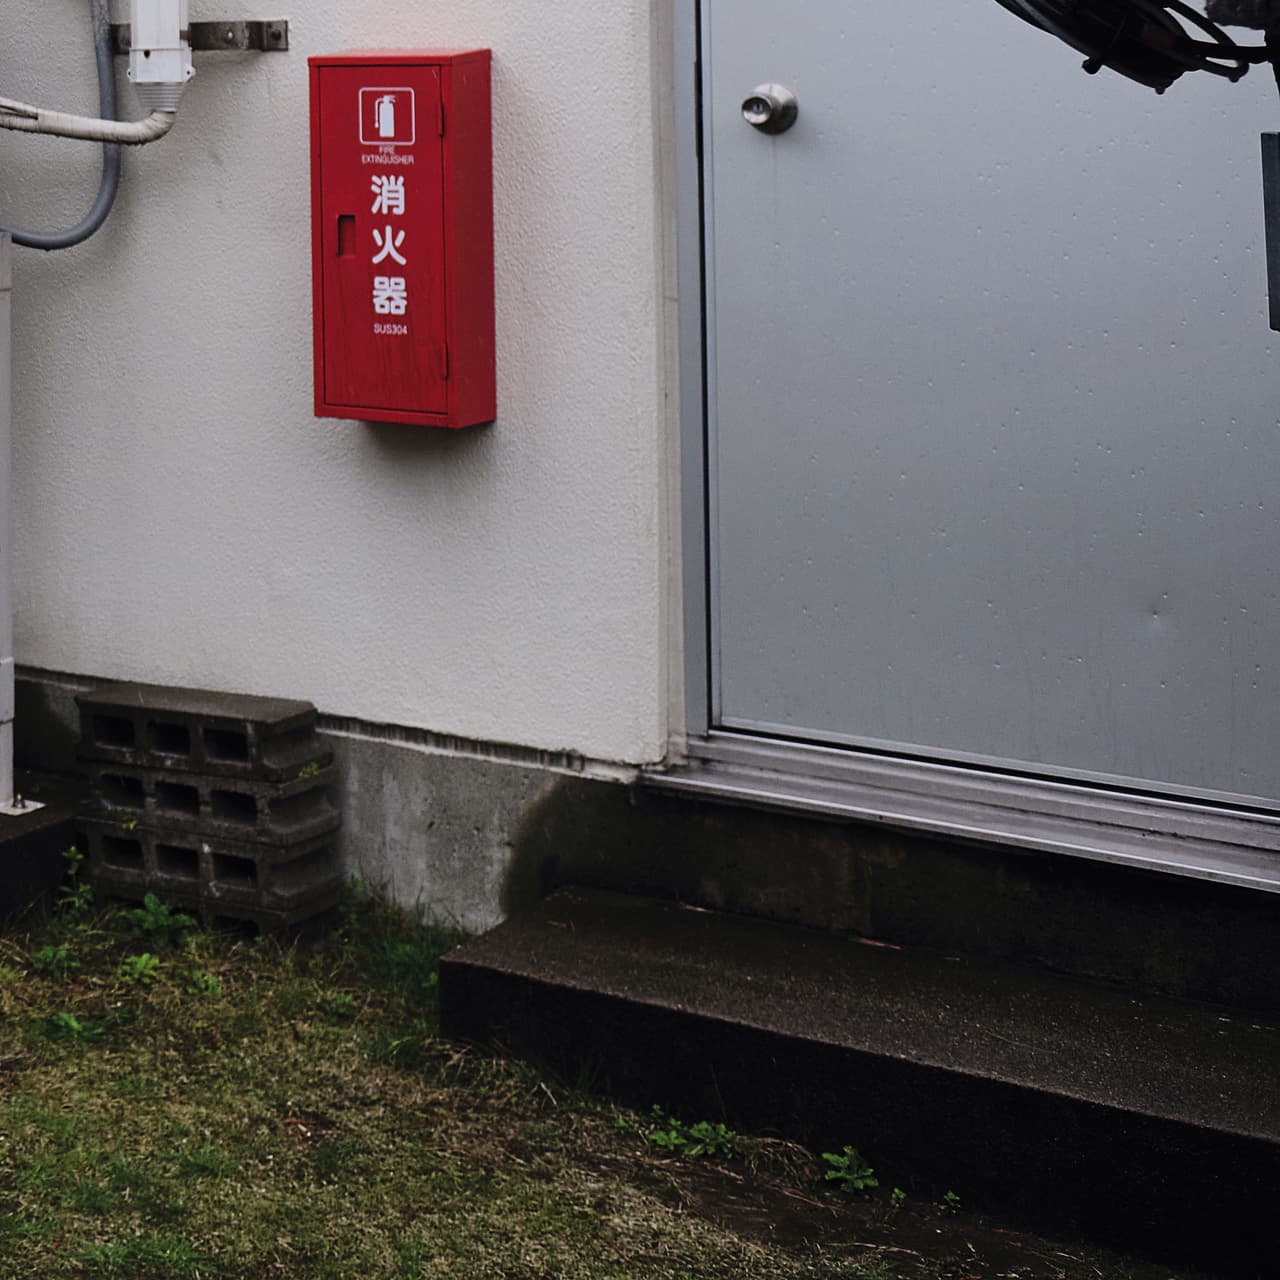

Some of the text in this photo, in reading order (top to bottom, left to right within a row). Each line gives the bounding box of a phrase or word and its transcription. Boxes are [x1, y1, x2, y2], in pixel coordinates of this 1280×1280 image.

[361, 154, 415, 165] EXTINGUISHER
[370, 174, 408, 316] 消火器
[373, 322, 408, 336] SUS304
